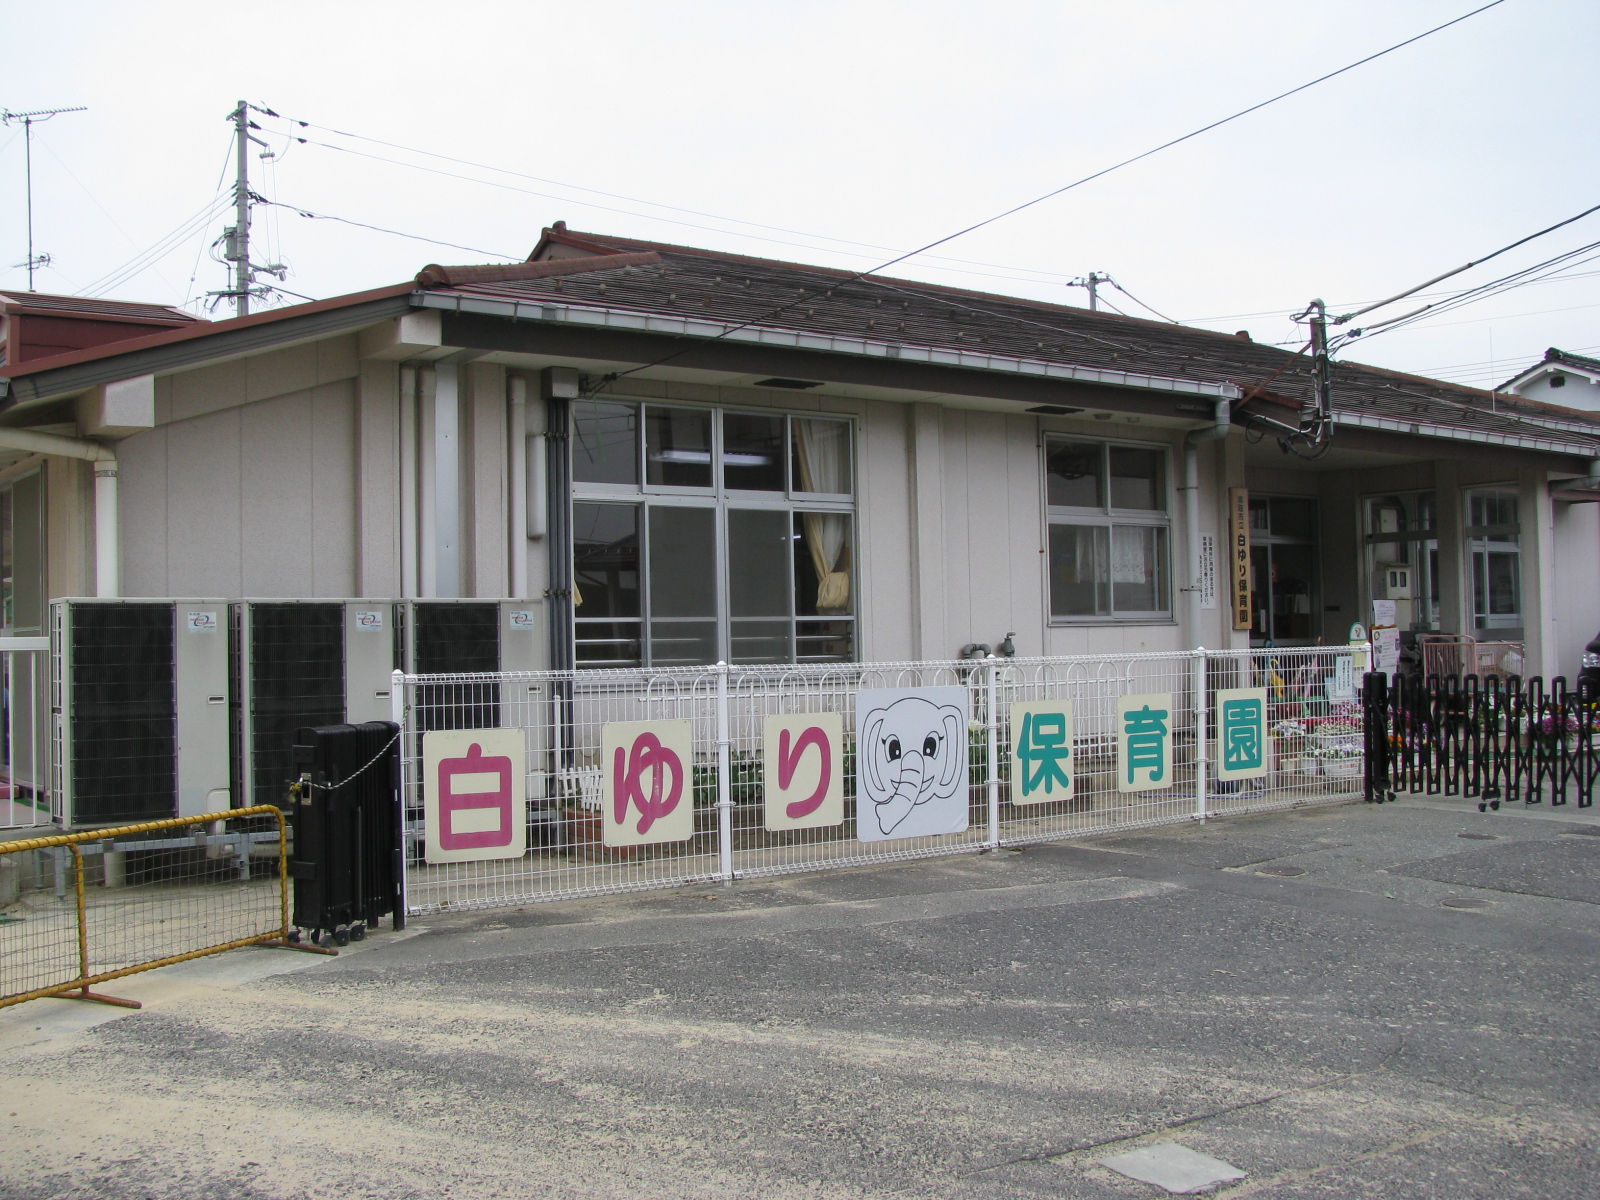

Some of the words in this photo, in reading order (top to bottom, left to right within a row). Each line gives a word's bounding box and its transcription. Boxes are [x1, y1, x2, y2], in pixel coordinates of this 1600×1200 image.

[1237, 533, 1248, 623] 白ゆり保育園
[439, 743, 512, 850] 白
[614, 732, 683, 834] ゆ
[779, 727, 830, 818] り
[1017, 711, 1069, 796] 保
[1124, 705, 1168, 784] 育
[1224, 698, 1262, 770] 園
